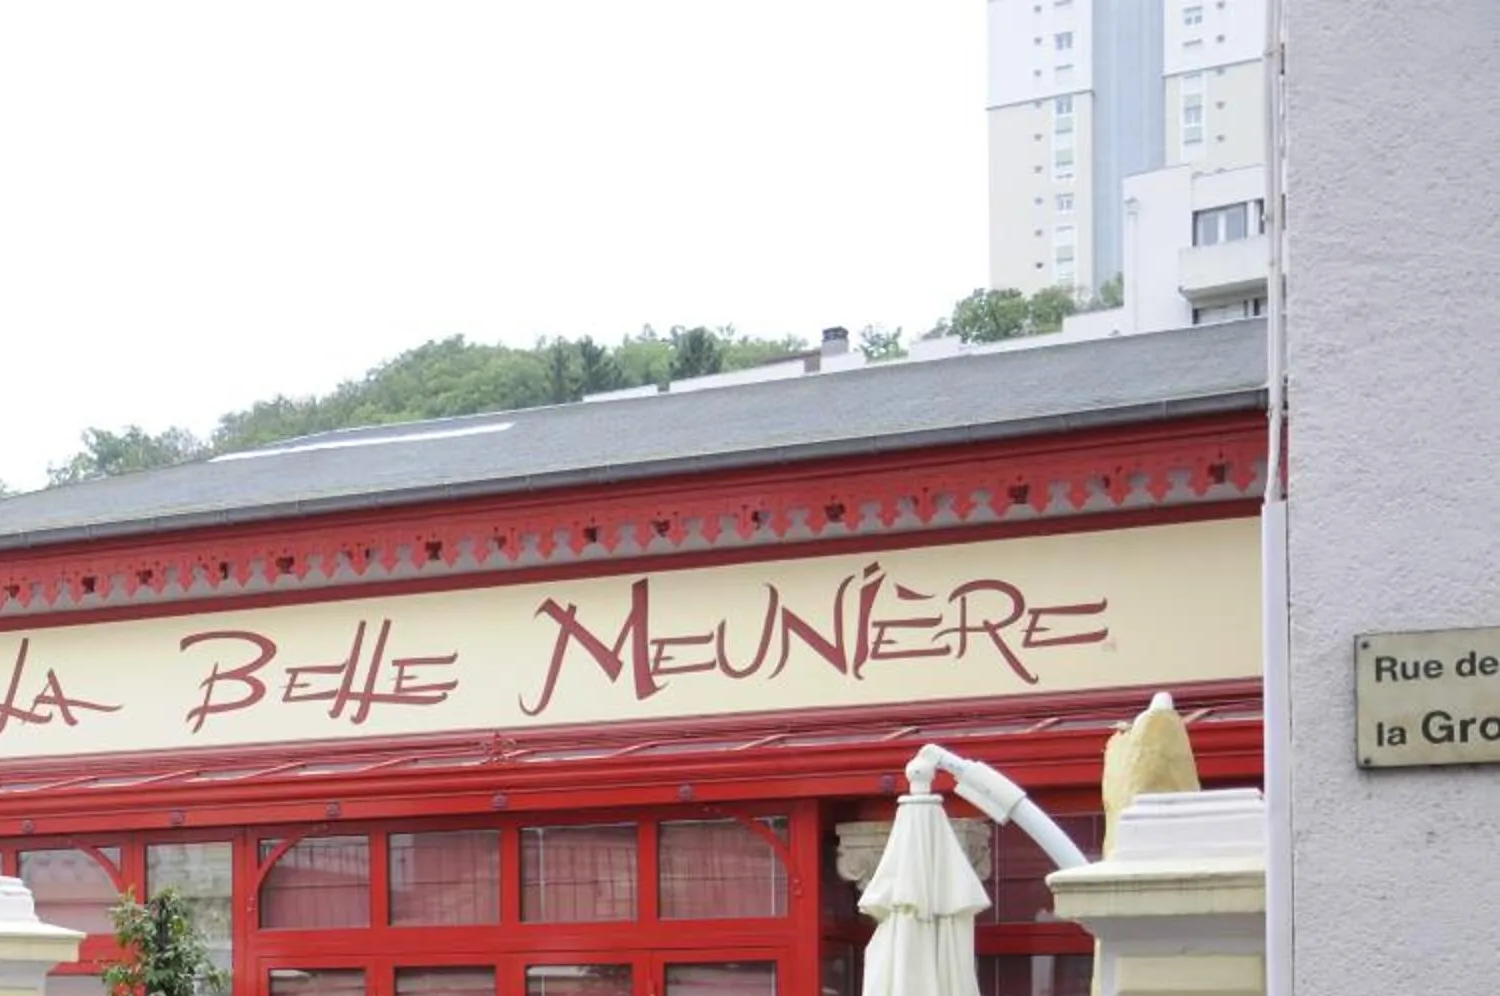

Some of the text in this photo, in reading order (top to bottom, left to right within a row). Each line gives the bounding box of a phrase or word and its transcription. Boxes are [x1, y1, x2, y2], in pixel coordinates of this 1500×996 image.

[180, 619, 459, 733] BELLE
[1375, 650, 1499, 682] Rue de
[1376, 710, 1500, 747] la Gro
